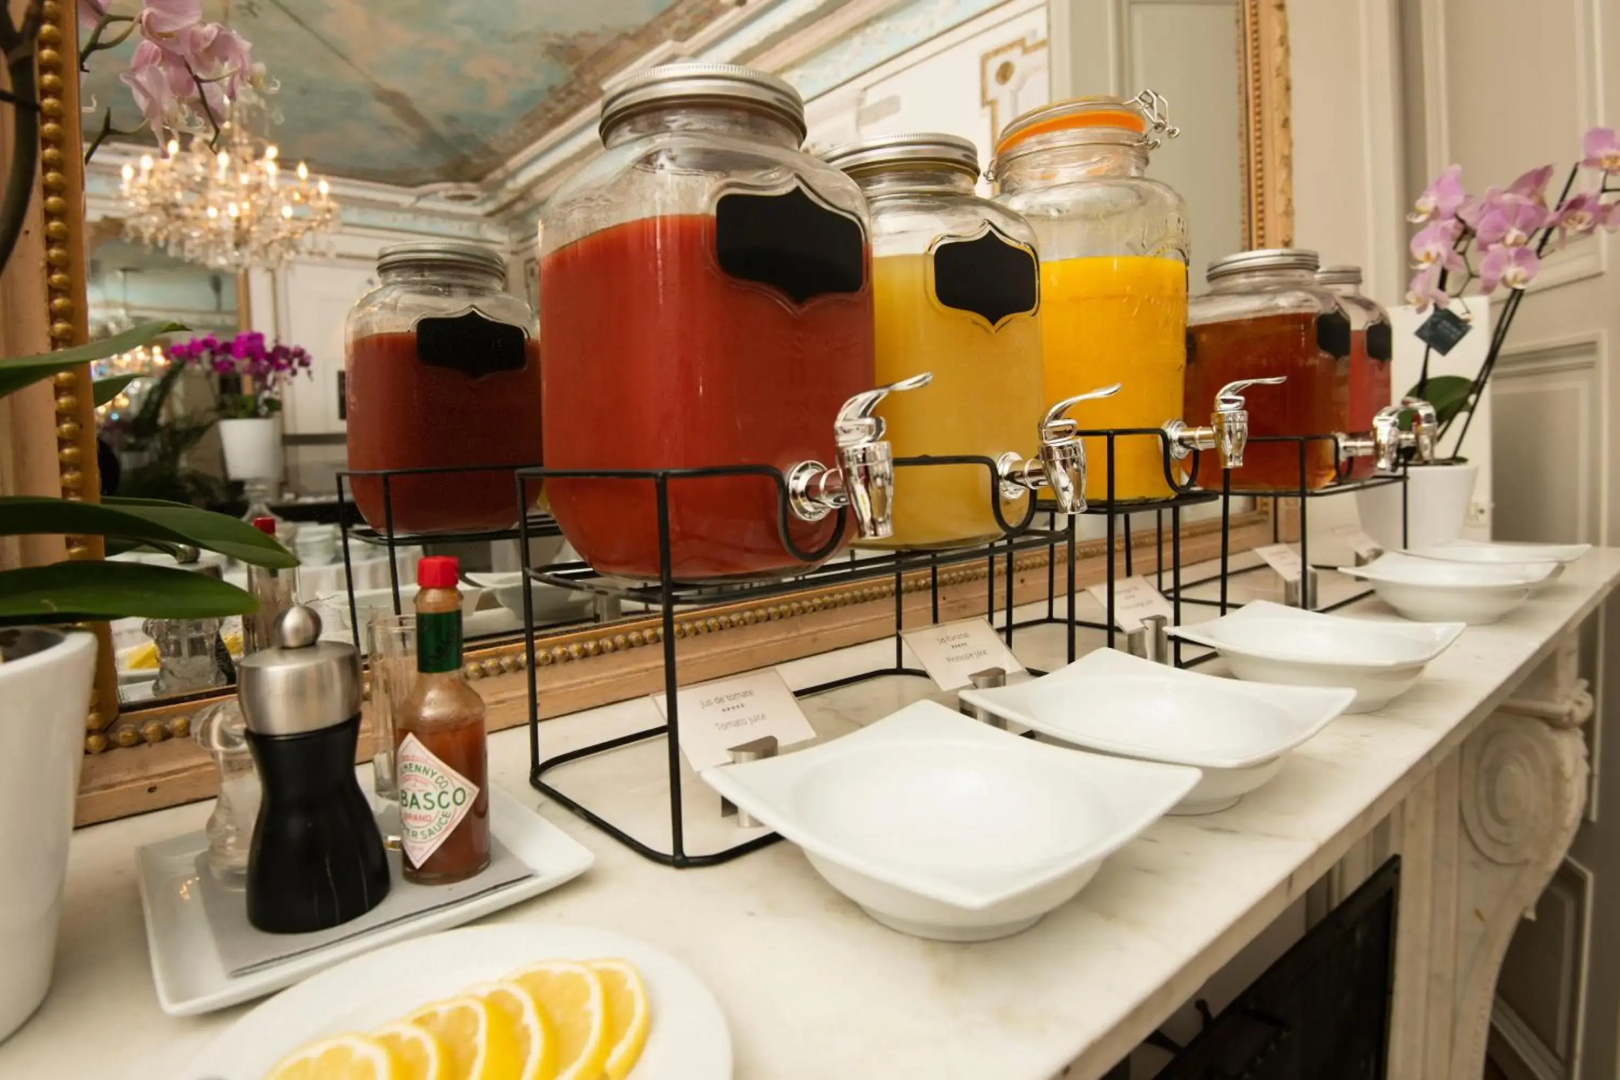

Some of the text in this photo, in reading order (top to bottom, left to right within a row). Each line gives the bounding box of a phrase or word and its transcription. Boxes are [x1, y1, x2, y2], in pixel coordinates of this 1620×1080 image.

[714, 718, 748, 731] Tomato
[400, 787, 467, 811] BASCO
[420, 810, 451, 839] SAUCE
